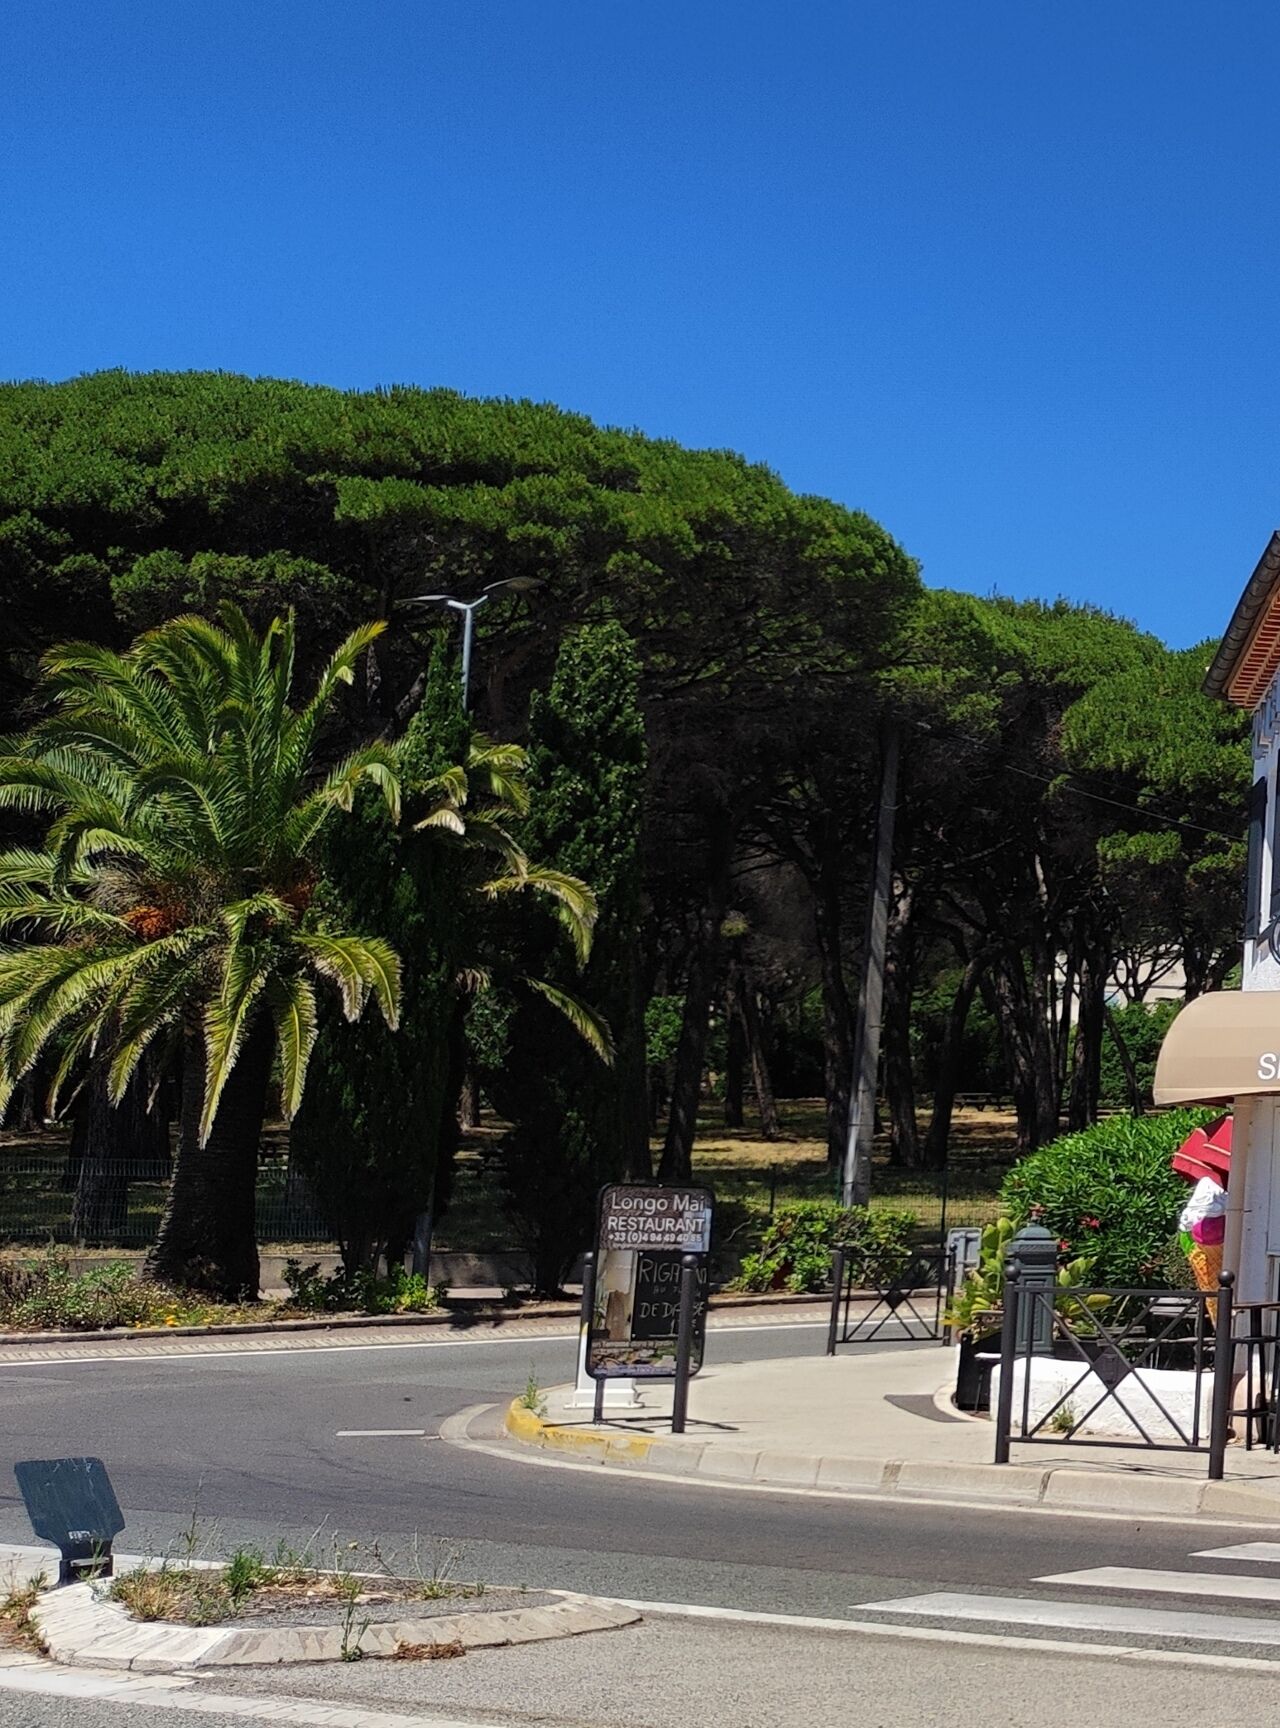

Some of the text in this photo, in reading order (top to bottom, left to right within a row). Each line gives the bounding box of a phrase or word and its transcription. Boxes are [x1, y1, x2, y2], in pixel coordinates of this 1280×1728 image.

[611, 1192, 705, 1216] Longo Mai
[607, 1216, 706, 1232] RESTAURANT
